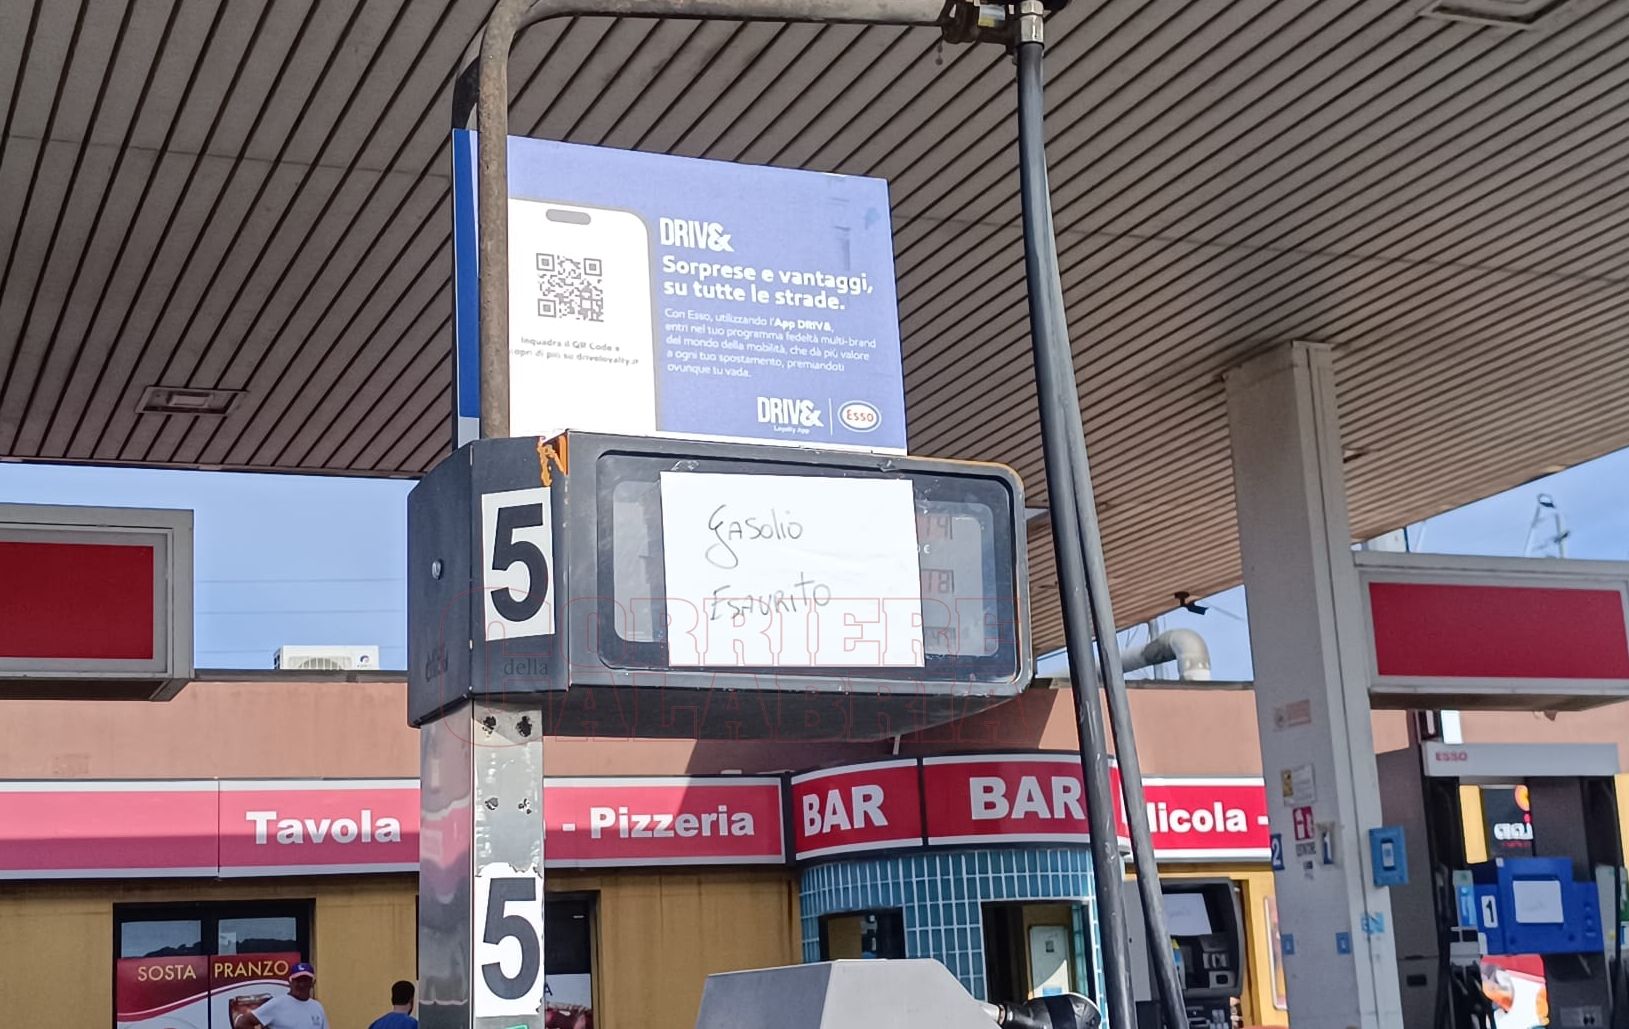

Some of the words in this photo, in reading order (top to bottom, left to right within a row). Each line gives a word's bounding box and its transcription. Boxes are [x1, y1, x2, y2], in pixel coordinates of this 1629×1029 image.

[659, 217, 735, 252] DRIV&
[662, 255, 756, 281] Sorprese
[761, 268, 774, 283] e
[778, 270, 873, 296] vantaggi,
[663, 280, 688, 296] su
[692, 280, 746, 301] tutte
[750, 284, 769, 303] le
[774, 290, 846, 310] strade.
[664, 308, 686, 319] Con
[687, 309, 713, 322] Esso,
[715, 313, 768, 326] utilizzando
[521, 336, 562, 347] Inquadra
[589, 342, 612, 352] Code
[664, 323, 688, 333] entri
[690, 323, 706, 334] nel
[707, 326, 725, 335] tuo
[726, 328, 784, 340] programma
[785, 331, 819, 344] fedeltà
[820, 336, 877, 349] multi-brand
[665, 334, 681, 345] del
[683, 337, 720, 348] mondo
[720, 339, 745, 351] della
[746, 341, 788, 355] mobilità,
[789, 345, 808, 356] che
[808, 346, 822, 357] dà
[823, 348, 839, 360] più
[840, 350, 870, 361] valore
[666, 350, 673, 358] a
[674, 350, 698, 361] ogni
[699, 351, 717, 361] tuo
[718, 354, 785, 368] spostamento,
[787, 360, 845, 372] premiandoti
[667, 363, 712, 376] ovunque
[712, 366, 724, 375] tu
[757, 396, 825, 427] DRIV&
[490, 502, 549, 622] 5
[1435, 751, 1468, 762] ESSO
[802, 784, 889, 838] BAR
[969, 775, 1085, 821] BAR
[245, 809, 401, 845] Tavola
[590, 805, 755, 839] Pizzeria
[1486, 900, 1495, 923] 1
[481, 877, 541, 1000] 5
[138, 964, 197, 982] SOSTA
[214, 960, 289, 979] PRANZO
